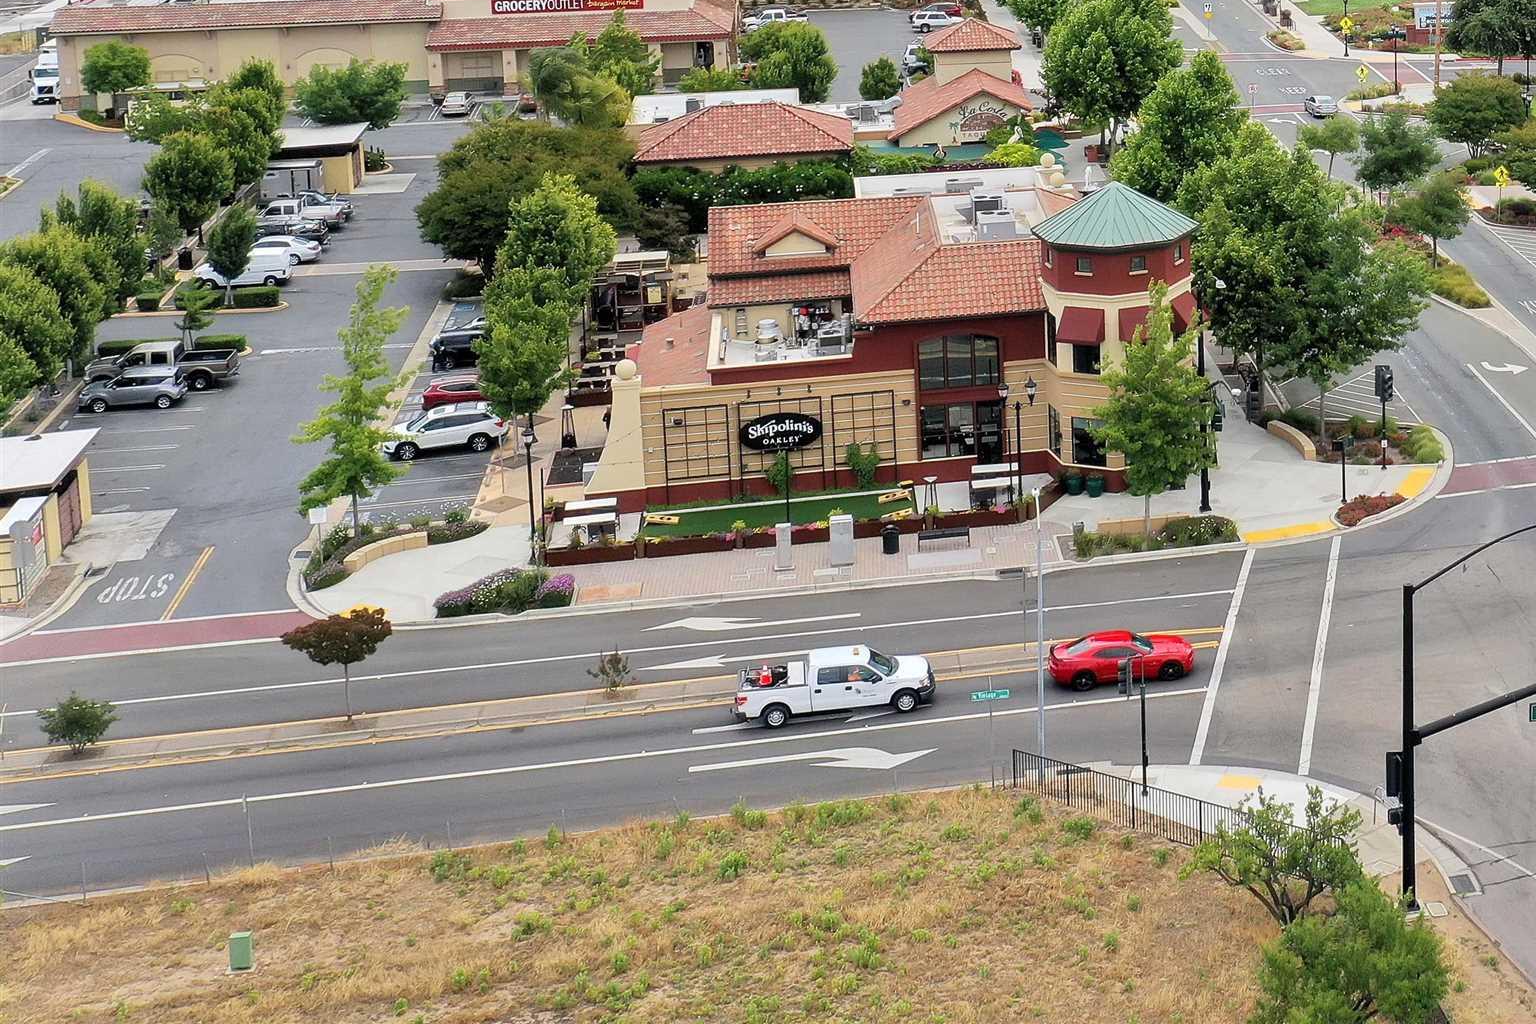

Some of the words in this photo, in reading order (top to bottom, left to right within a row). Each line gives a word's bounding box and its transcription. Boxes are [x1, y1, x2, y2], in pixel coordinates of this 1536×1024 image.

[959, 105, 976, 119] La
[979, 101, 1007, 118] Costa
[748, 419, 814, 439] Skipolini's
[762, 436, 800, 445] OAKLEY
[97, 573, 175, 604] STOP
